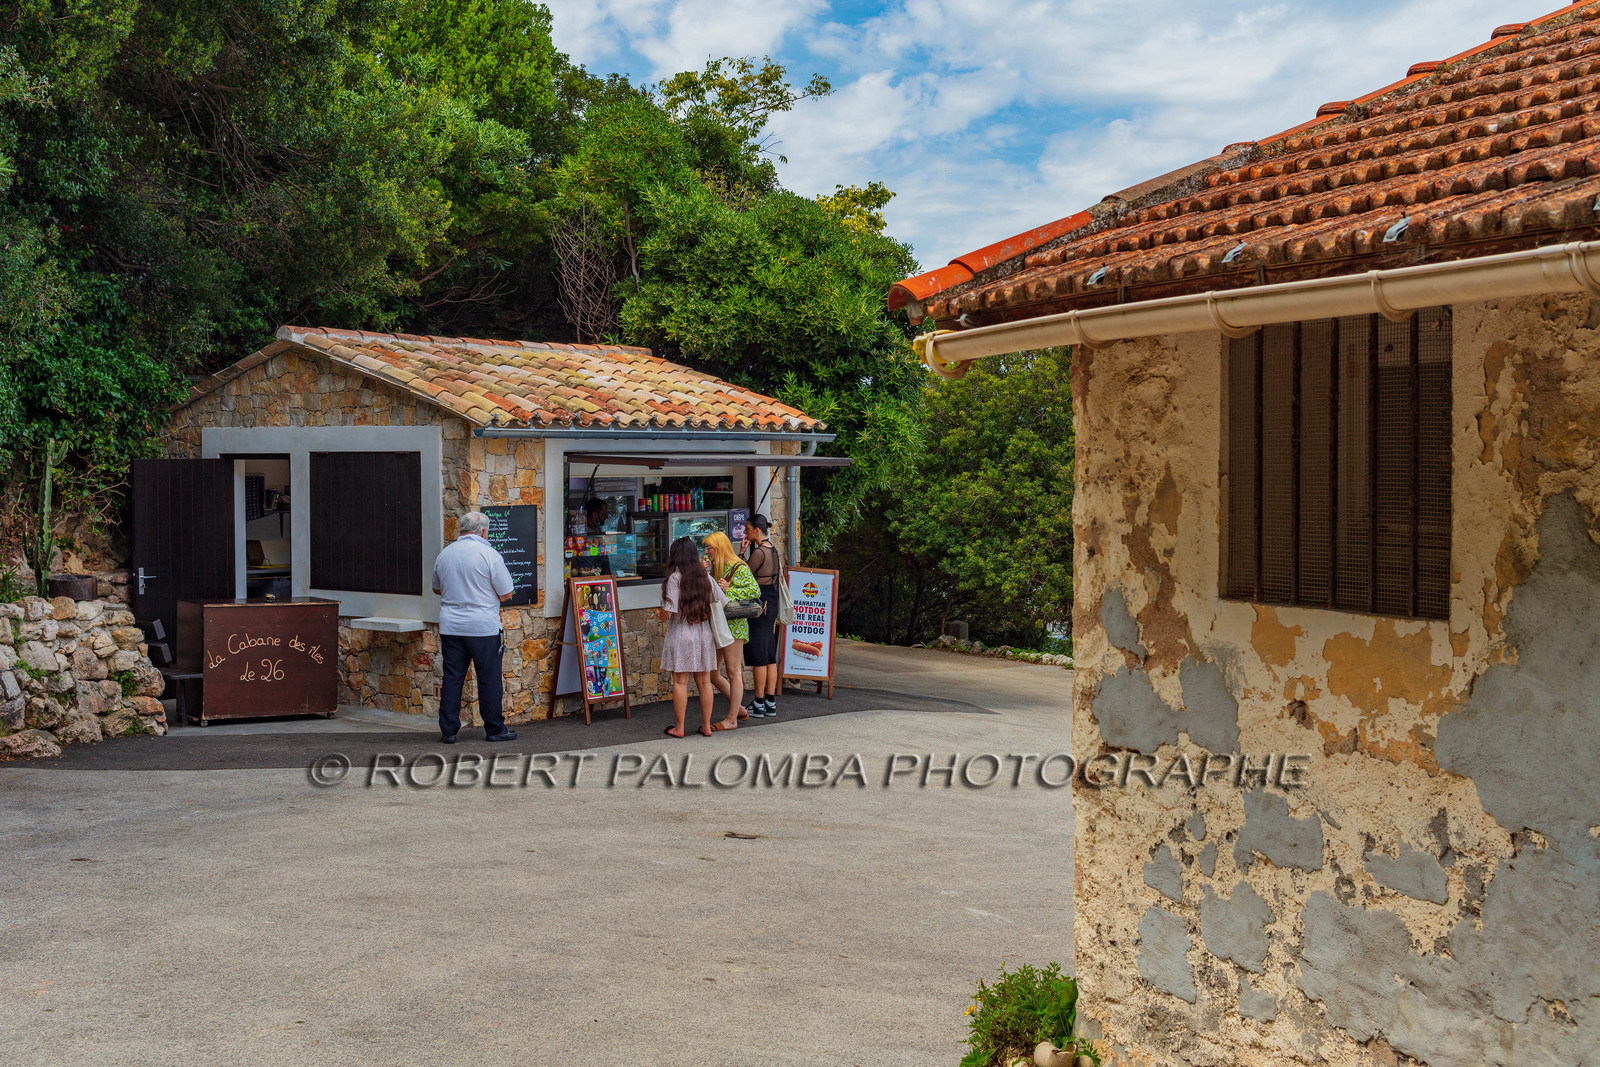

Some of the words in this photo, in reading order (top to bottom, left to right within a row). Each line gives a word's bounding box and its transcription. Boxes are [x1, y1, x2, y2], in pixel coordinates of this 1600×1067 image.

[793, 600, 826, 608] MANHATTAN
[793, 605, 826, 615] HOTDOG
[807, 614, 825, 622] REAL
[791, 625, 825, 635] HOTDOG
[206, 649, 226, 669] La
[227, 632, 281, 655] Cabane
[288, 634, 306, 652] des
[240, 661, 256, 682] Le
[260, 658, 285, 682] 26
